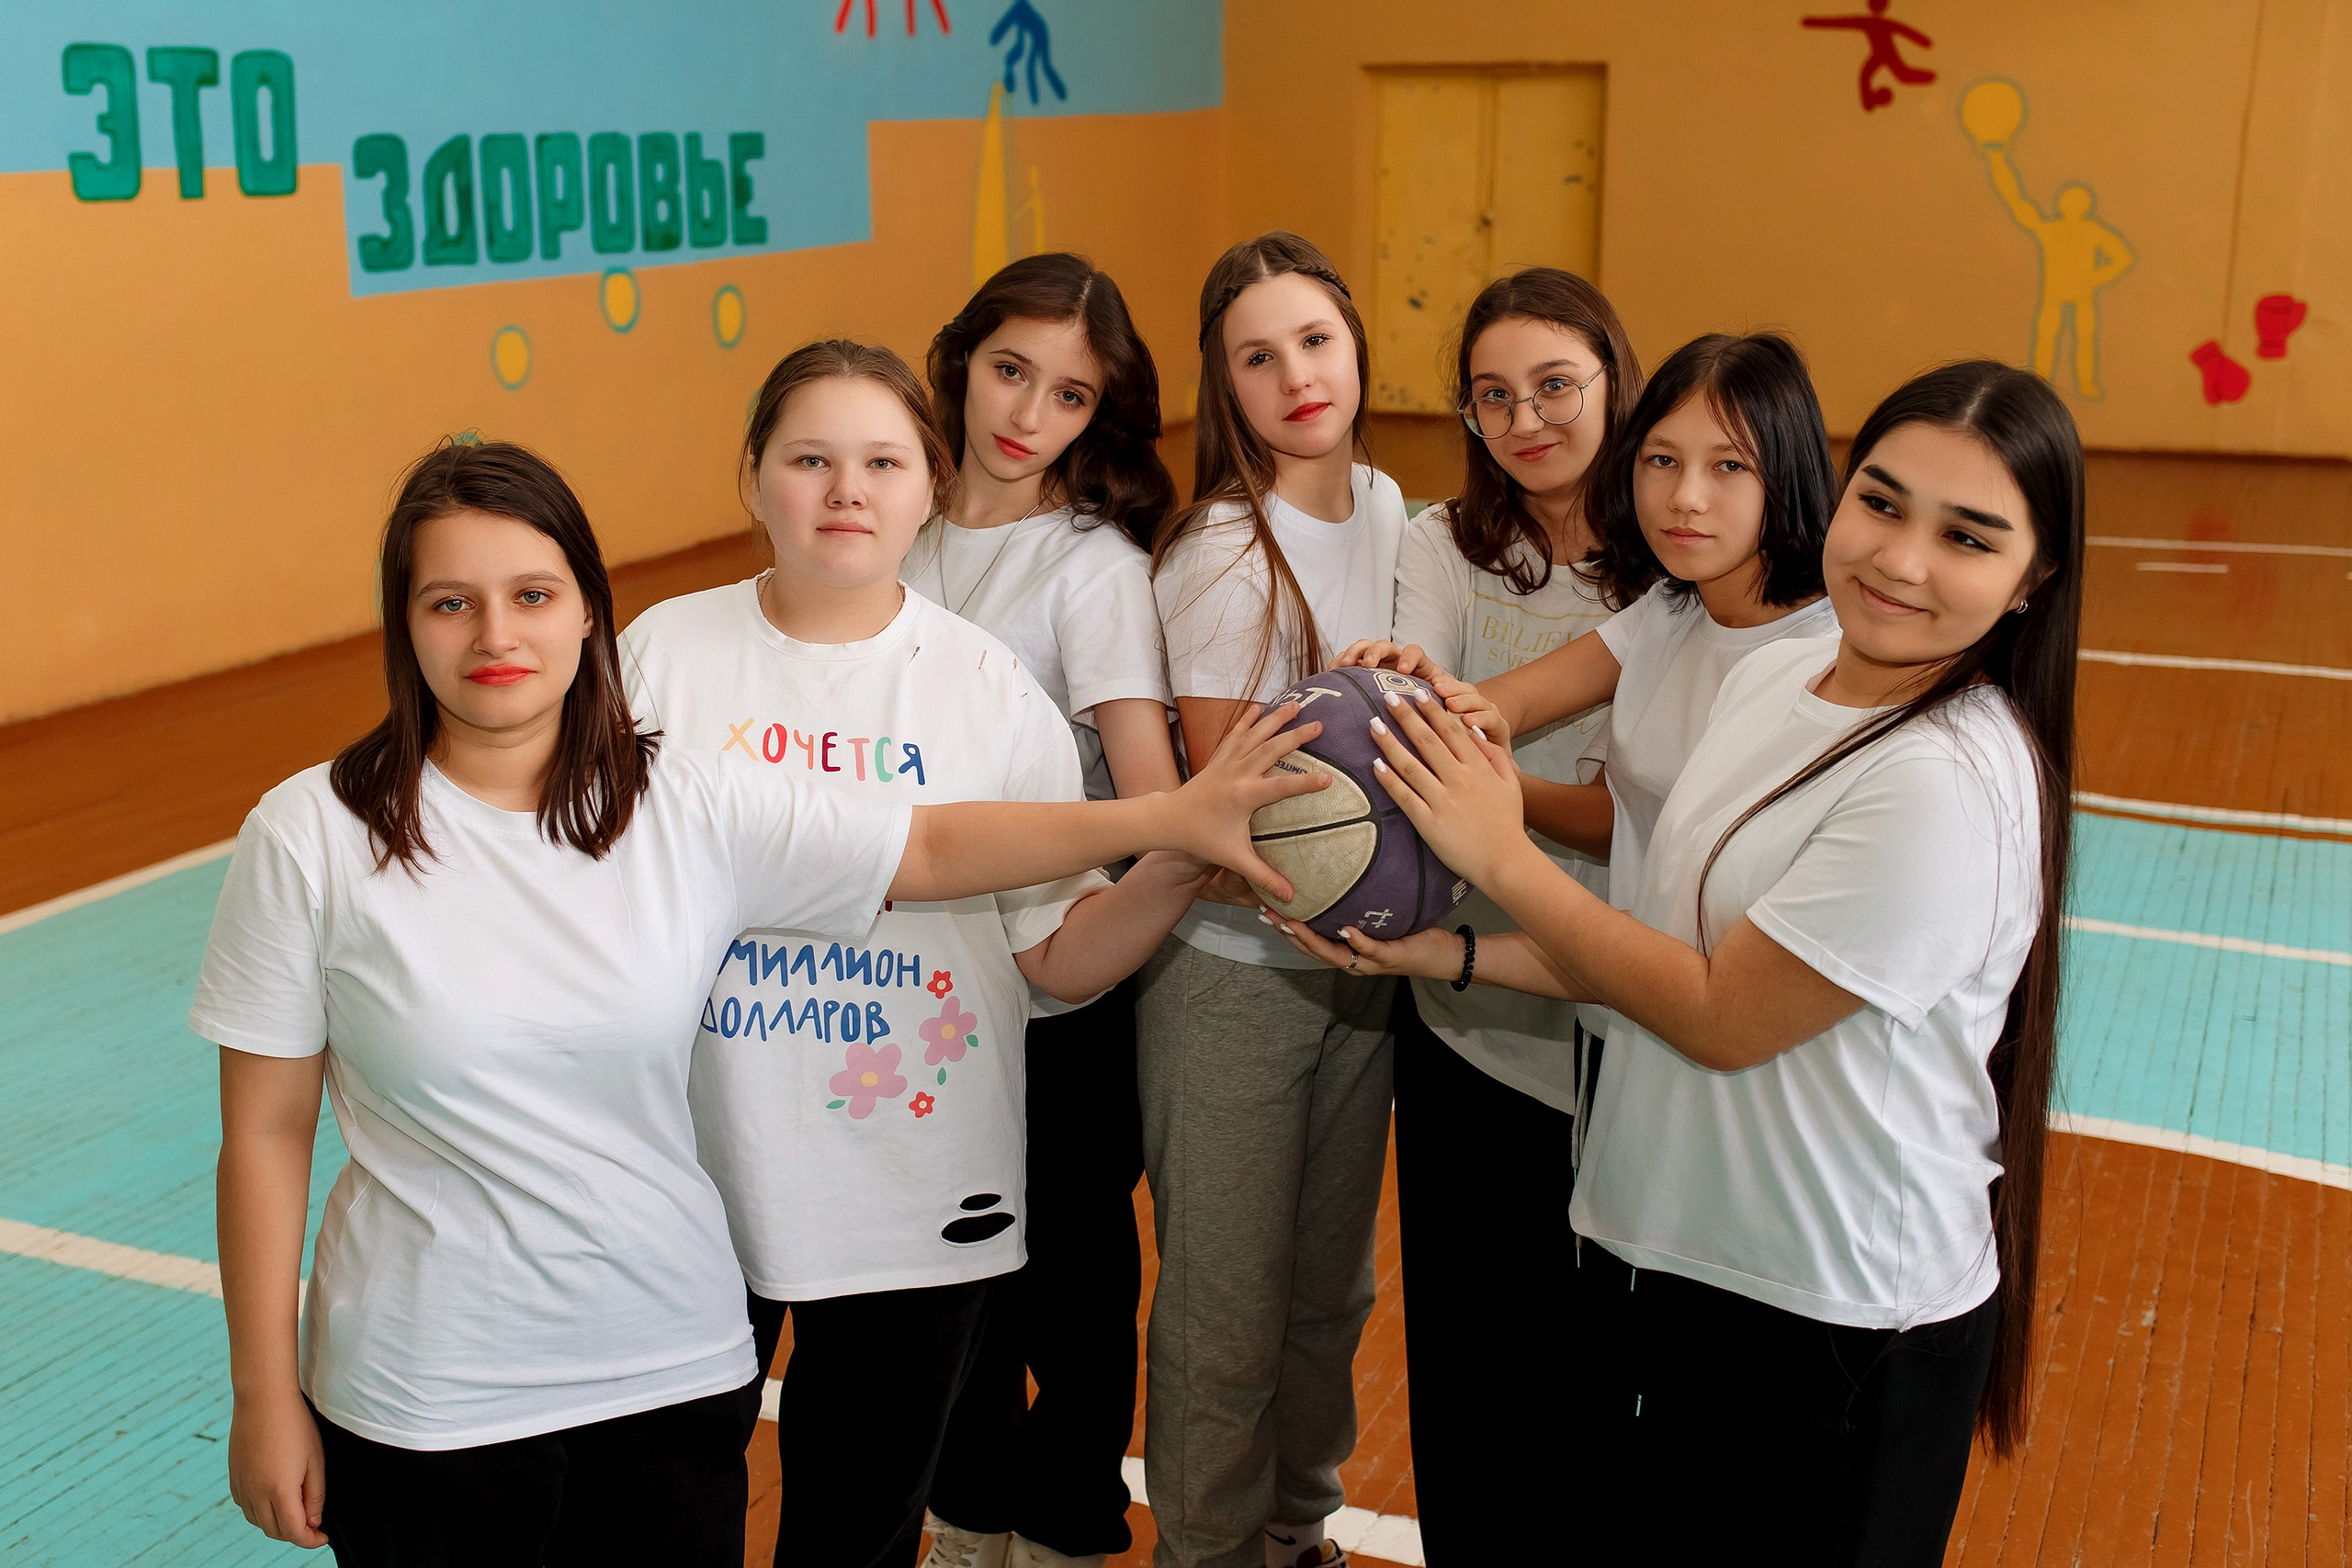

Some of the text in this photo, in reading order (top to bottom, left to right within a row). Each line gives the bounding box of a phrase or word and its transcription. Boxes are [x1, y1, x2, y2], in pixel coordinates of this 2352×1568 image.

[62, 42, 298, 201] ЭТО
[353, 131, 768, 272] ЗДОРОВЬЕ
[721, 717, 926, 785] ХОЧЕТСЯ
[718, 939, 921, 987] МИЛЛИОН
[700, 997, 891, 1044] ДОЛЛАРОВ
